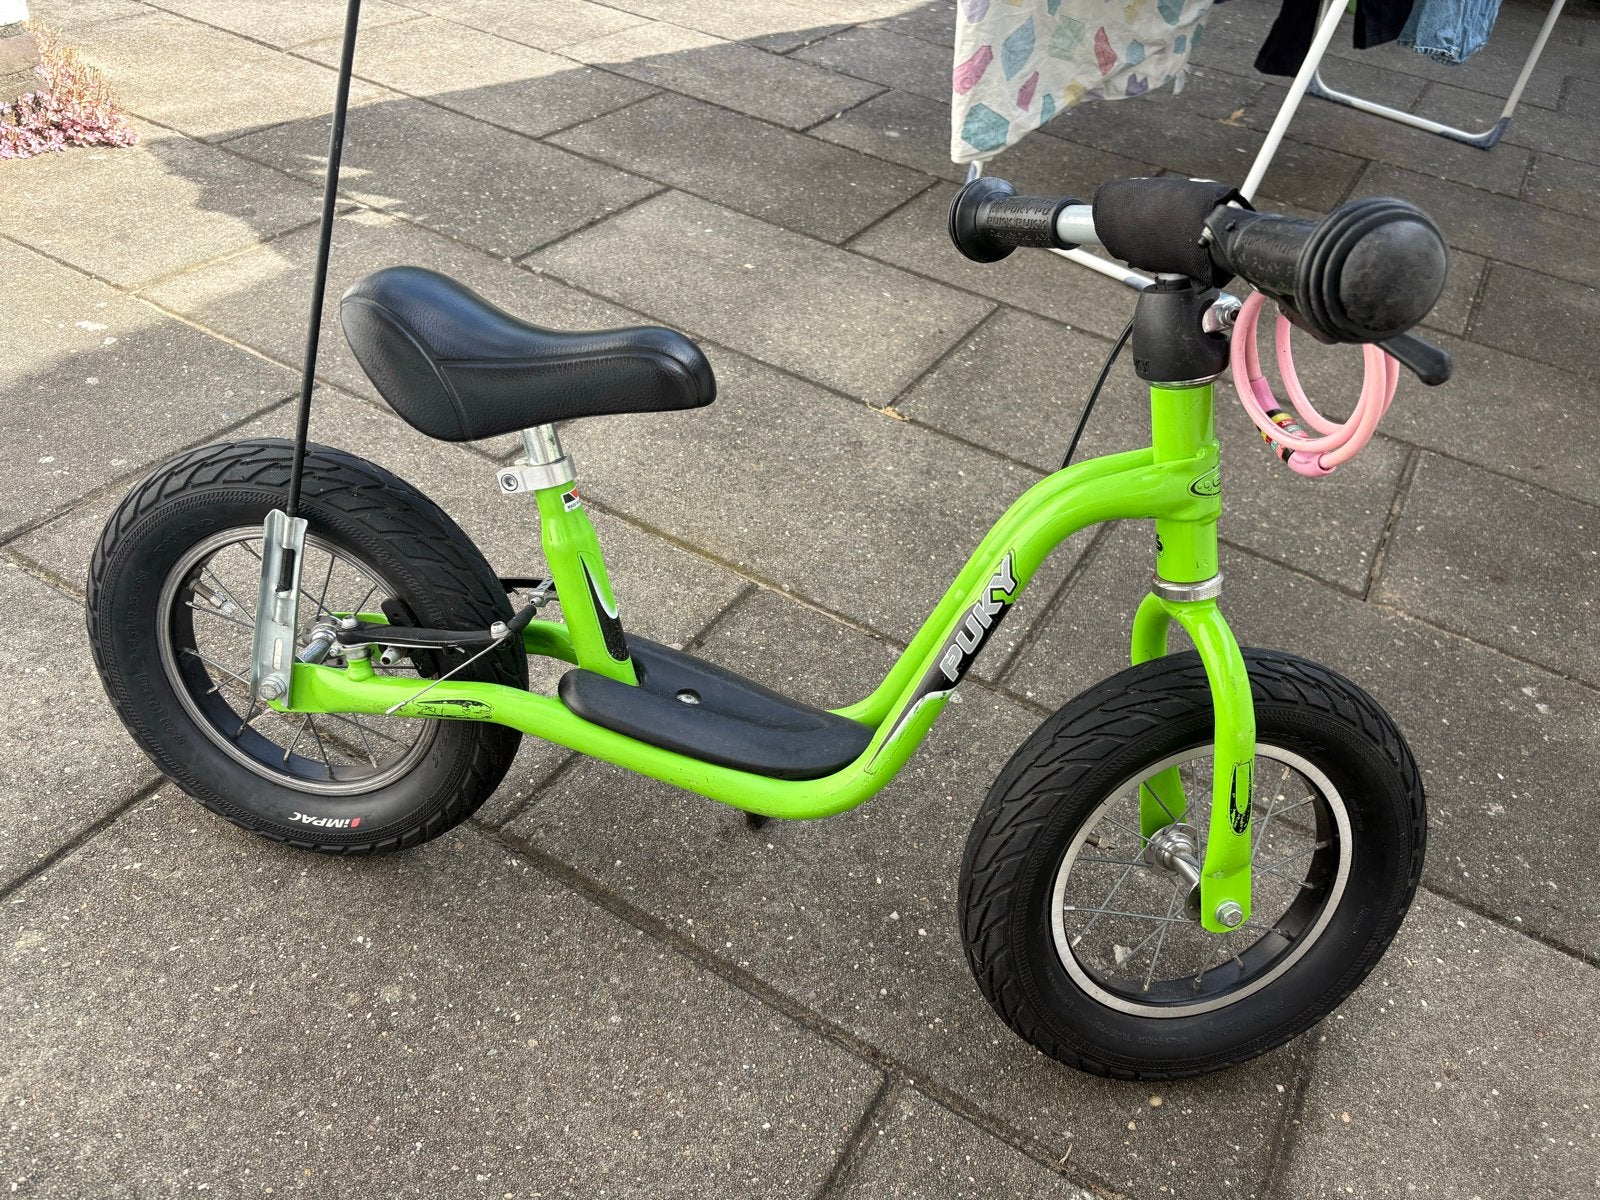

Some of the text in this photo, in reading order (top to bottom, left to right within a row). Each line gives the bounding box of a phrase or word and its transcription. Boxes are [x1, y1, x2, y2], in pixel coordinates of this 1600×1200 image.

[1015, 218, 1047, 229] PUKY
[940, 551, 1017, 682] PUKY
[288, 811, 351, 828] iMPAC
